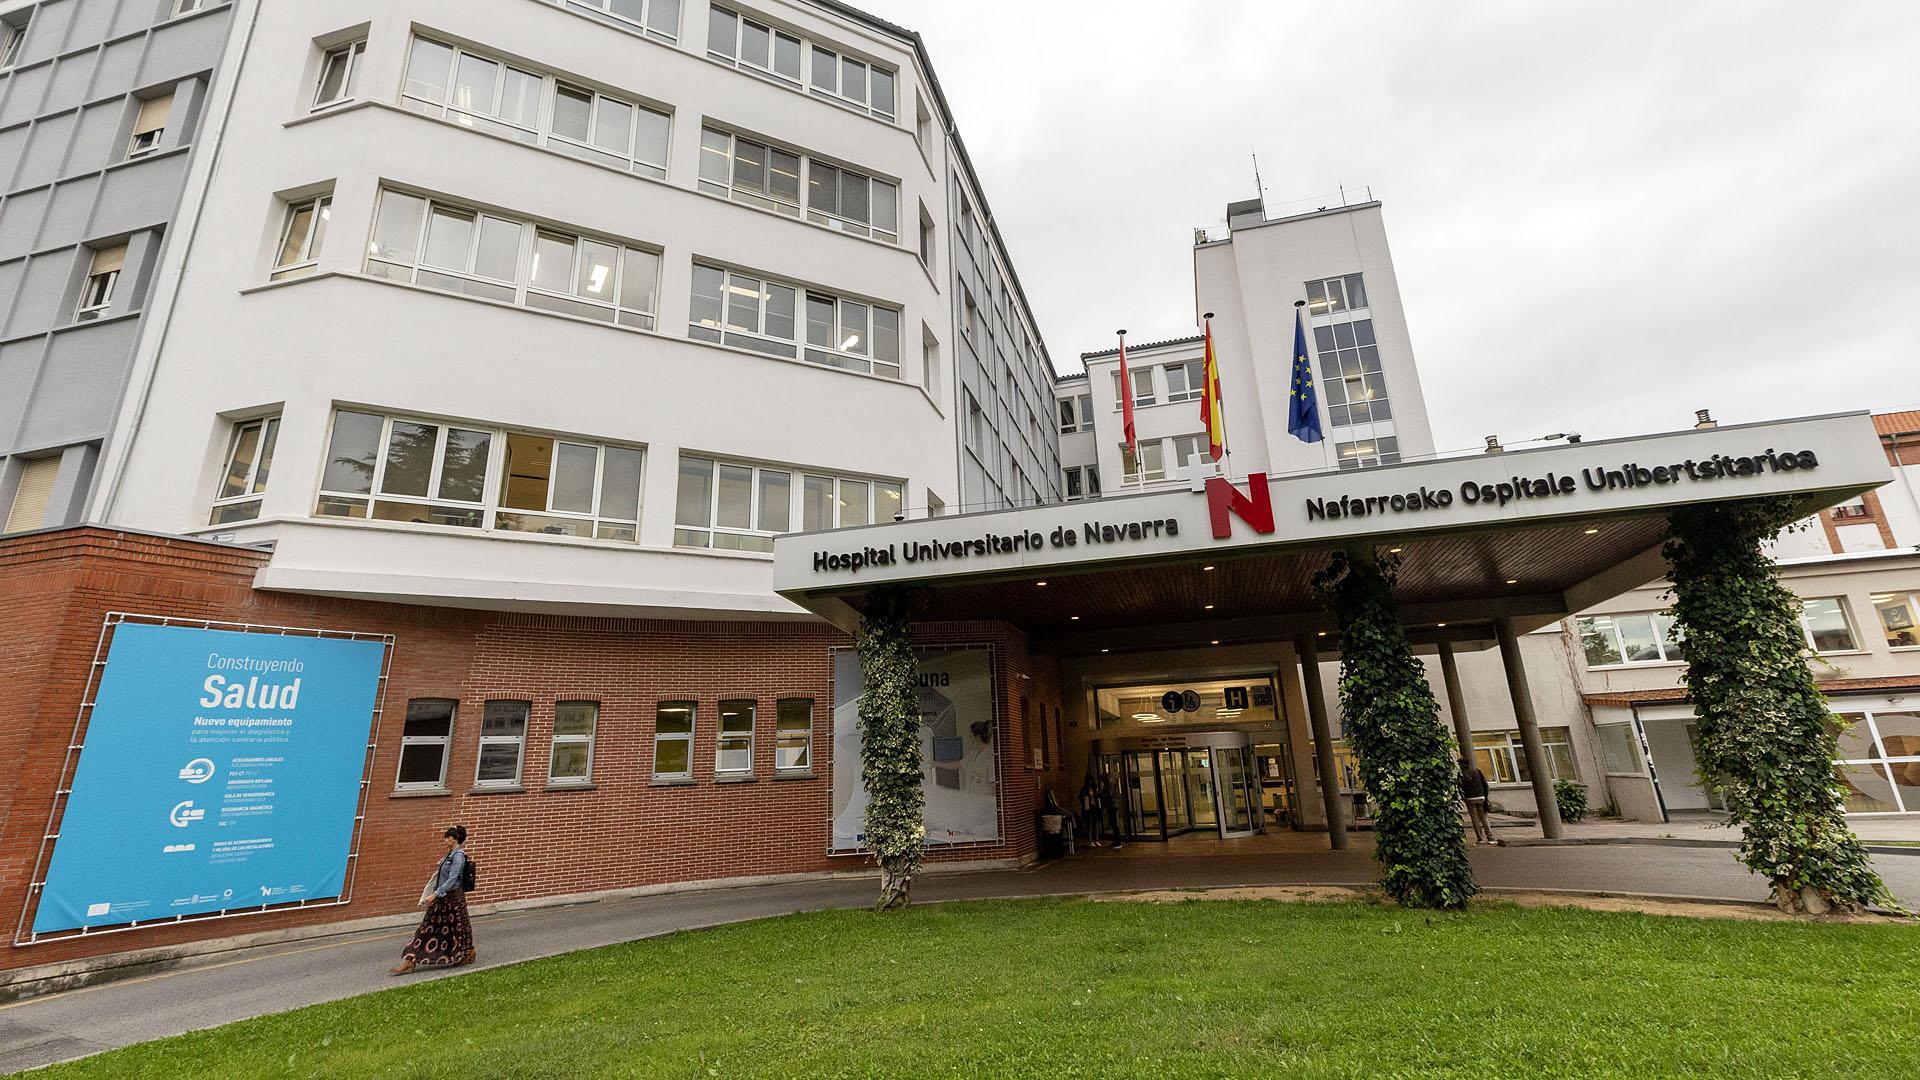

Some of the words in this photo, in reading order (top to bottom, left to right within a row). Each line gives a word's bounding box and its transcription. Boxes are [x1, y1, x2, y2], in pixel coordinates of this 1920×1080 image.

[1306, 486, 1453, 521] Nafarroako
[1460, 472, 1577, 507] Ospitale
[1582, 447, 1820, 492] Unibertsitarioa
[813, 543, 896, 573] Hospital
[902, 529, 1043, 562] Universitario
[1050, 525, 1077, 548] de
[1084, 515, 1180, 544] Navarra
[208, 653, 304, 675] Construyendo
[200, 674, 301, 710] Salud
[194, 716, 226, 726] Nuevo
[228, 716, 293, 728] equipamiento
